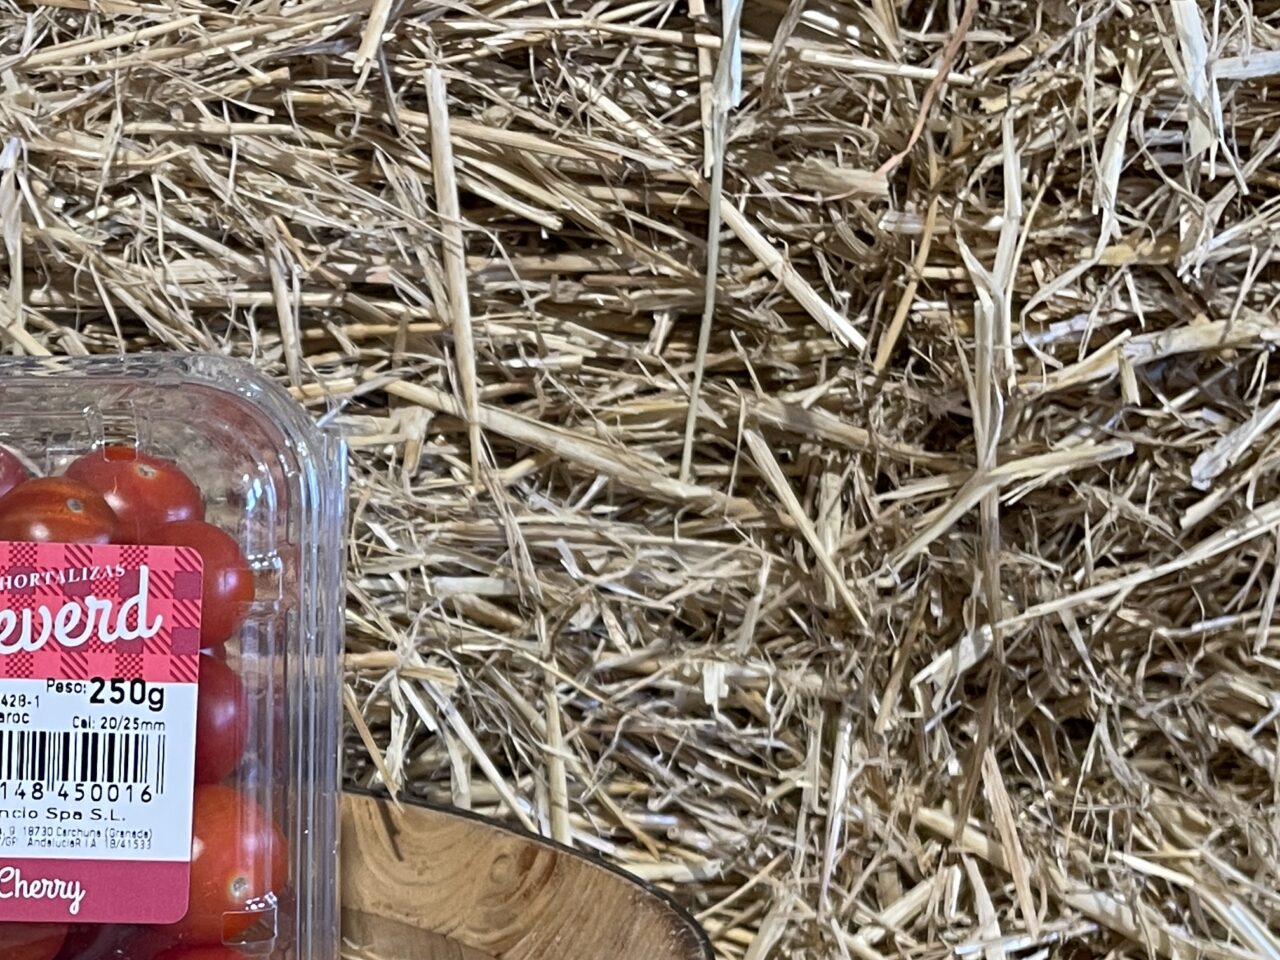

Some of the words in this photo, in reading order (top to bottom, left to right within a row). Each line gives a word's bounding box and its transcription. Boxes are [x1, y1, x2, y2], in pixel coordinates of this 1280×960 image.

[46, 677, 87, 694] Peso:
[89, 676, 165, 712] 250g
[72, 715, 96, 730] Cal:
[100, 715, 166, 731] 20/25mm
[57, 782, 152, 803] 450016
[46, 807, 83, 823] Spa
[89, 808, 126, 821] S.L.
